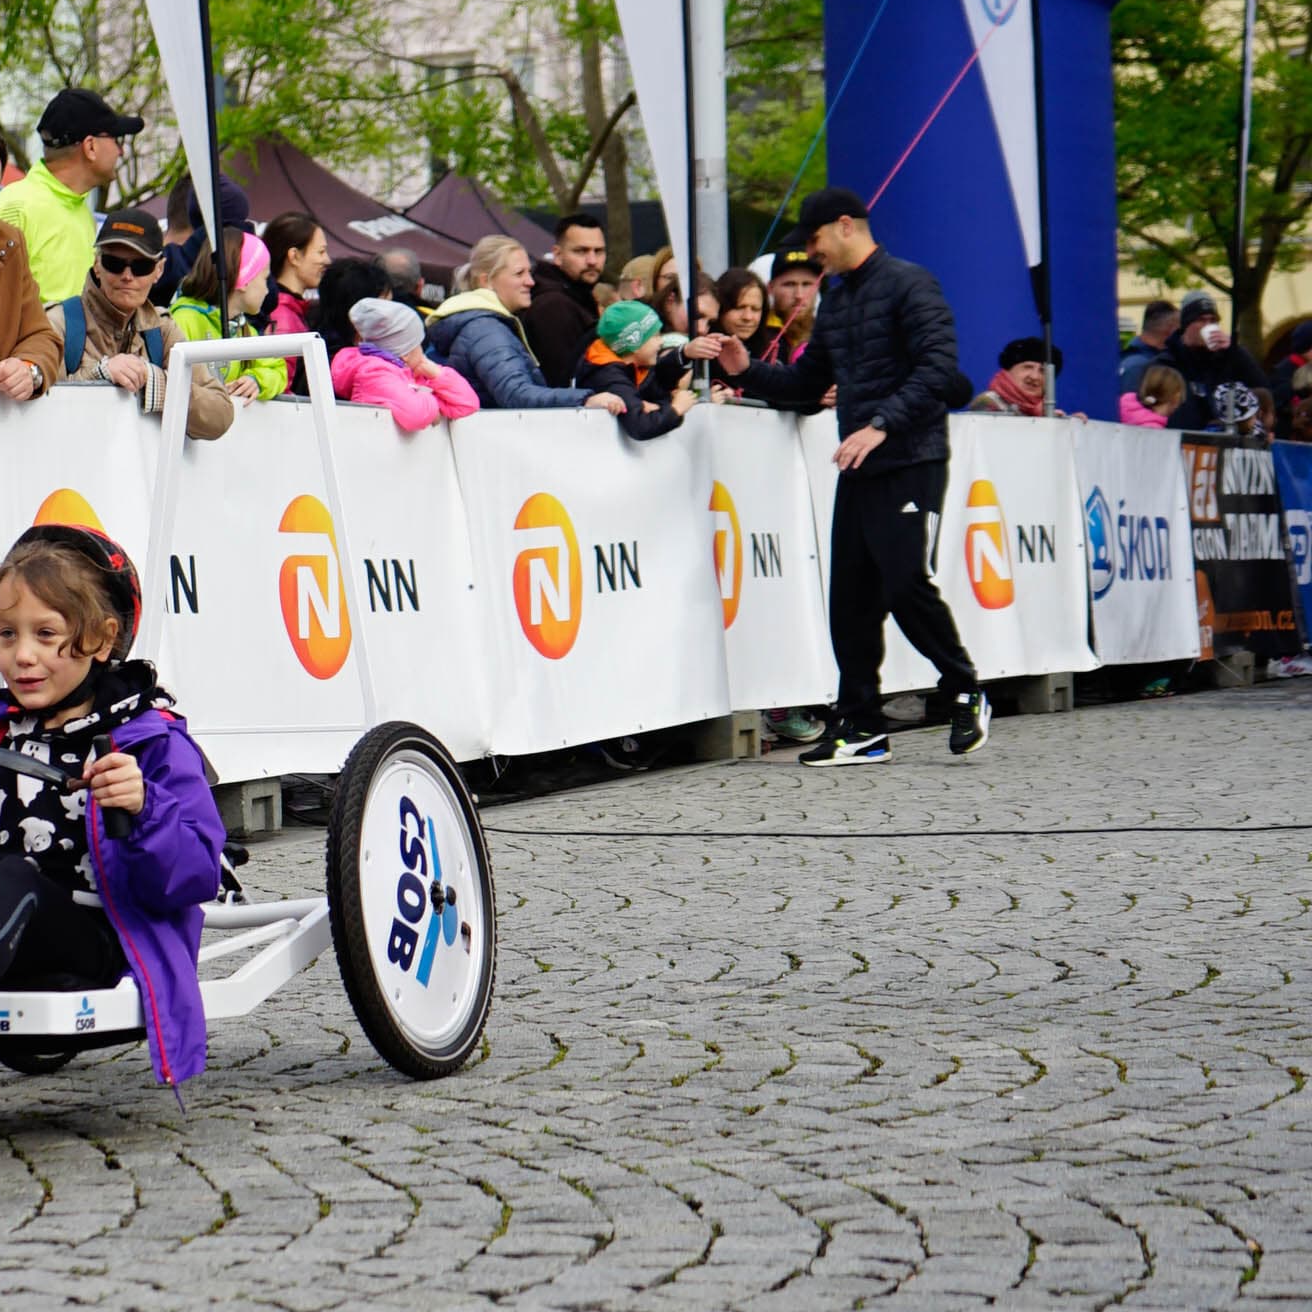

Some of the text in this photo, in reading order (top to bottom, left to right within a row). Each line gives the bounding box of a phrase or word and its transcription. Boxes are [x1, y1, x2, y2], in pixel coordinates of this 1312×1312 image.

[594, 541, 641, 593] NN
[751, 533, 783, 578] NN
[1017, 525, 1055, 562] NN
[166, 554, 199, 614] N
[363, 558, 420, 613] NN
